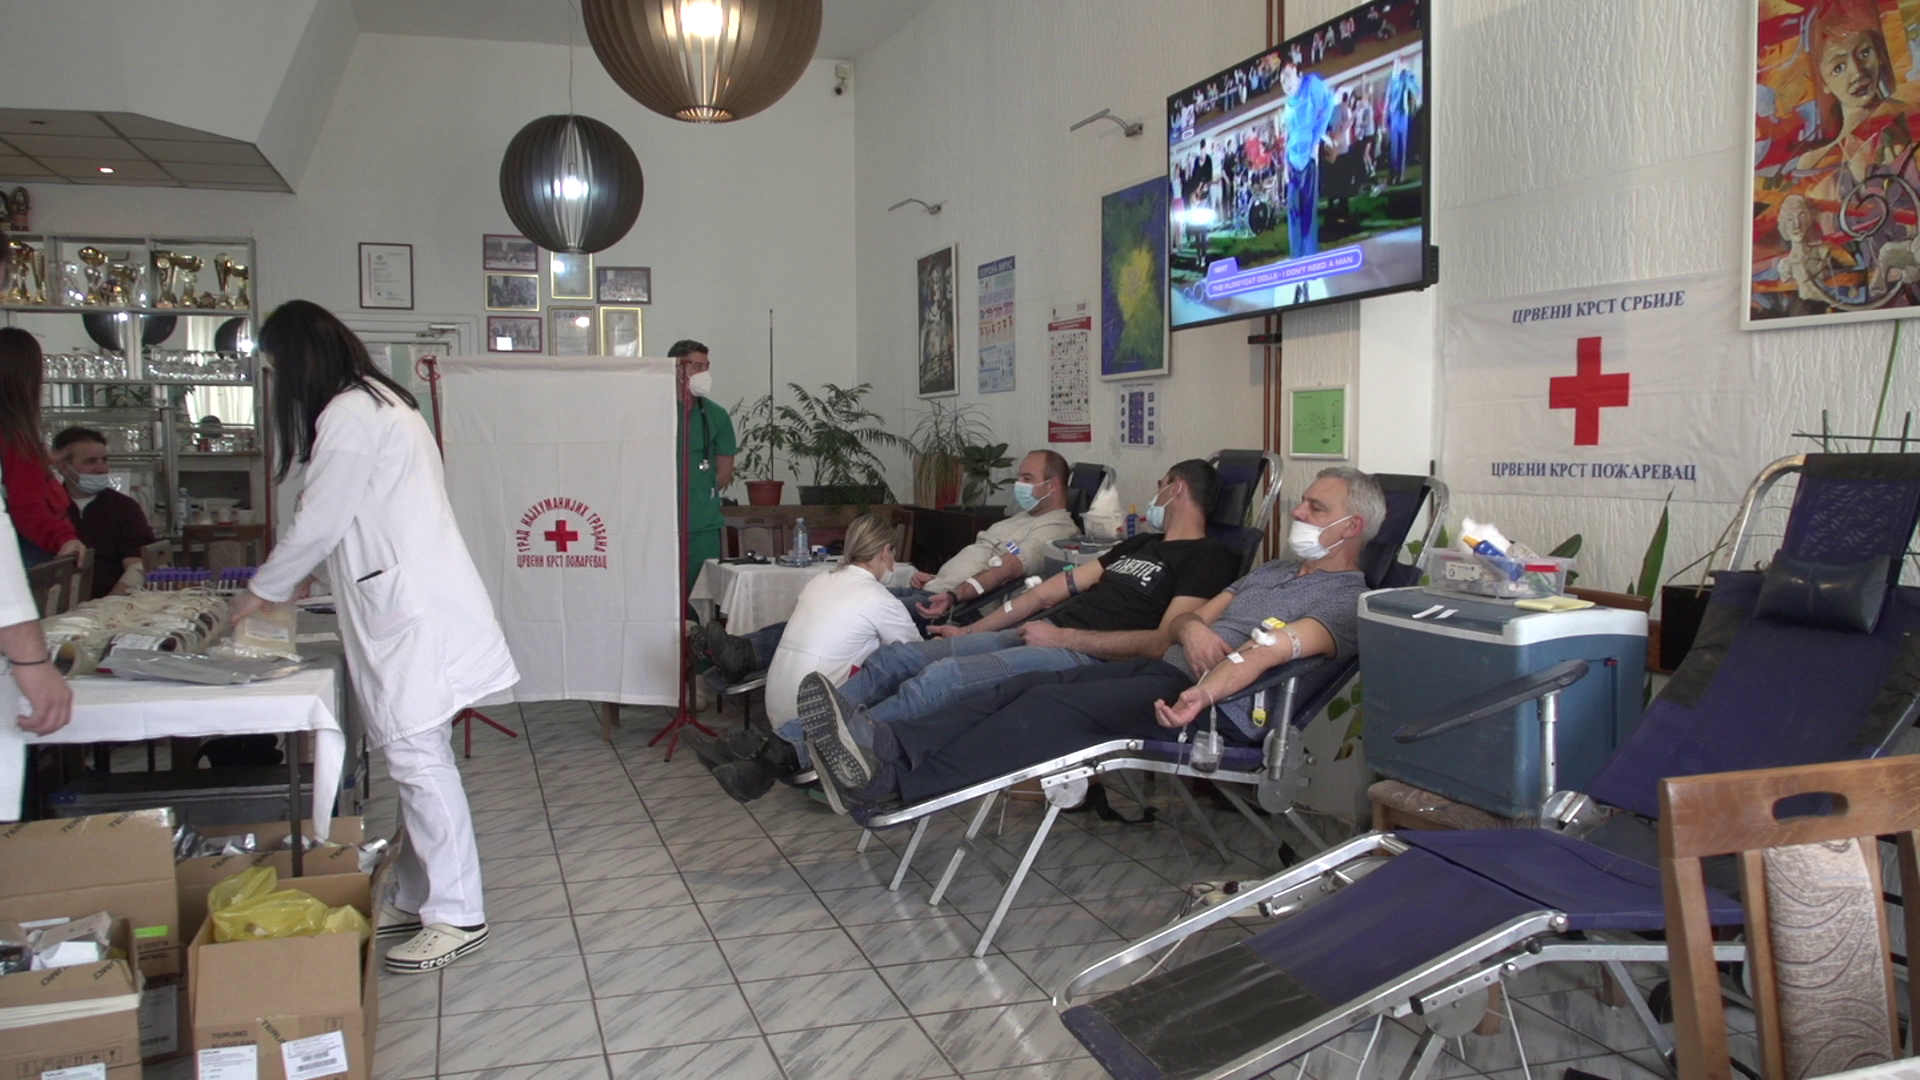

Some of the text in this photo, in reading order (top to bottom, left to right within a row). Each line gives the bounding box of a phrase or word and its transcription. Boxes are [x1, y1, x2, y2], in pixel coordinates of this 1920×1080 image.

[1257, 272, 1278, 283] DOLLS
[1335, 255, 1354, 266] MAN
[1512, 290, 1686, 325] ЦРВЕНИ КРСТ СРБИЈЕ
[1491, 462, 1697, 482] ЦРВЕНИ КРСТ ПОЖАРЕВАЦ
[520, 497, 590, 527] НАЈХУМАНИЈИХ
[516, 529, 531, 552] ГРАД
[517, 555, 607, 569] ЦРВЕНИ КРСТ ПОЖАРЕВАЦ
[420, 950, 457, 969] crocs
